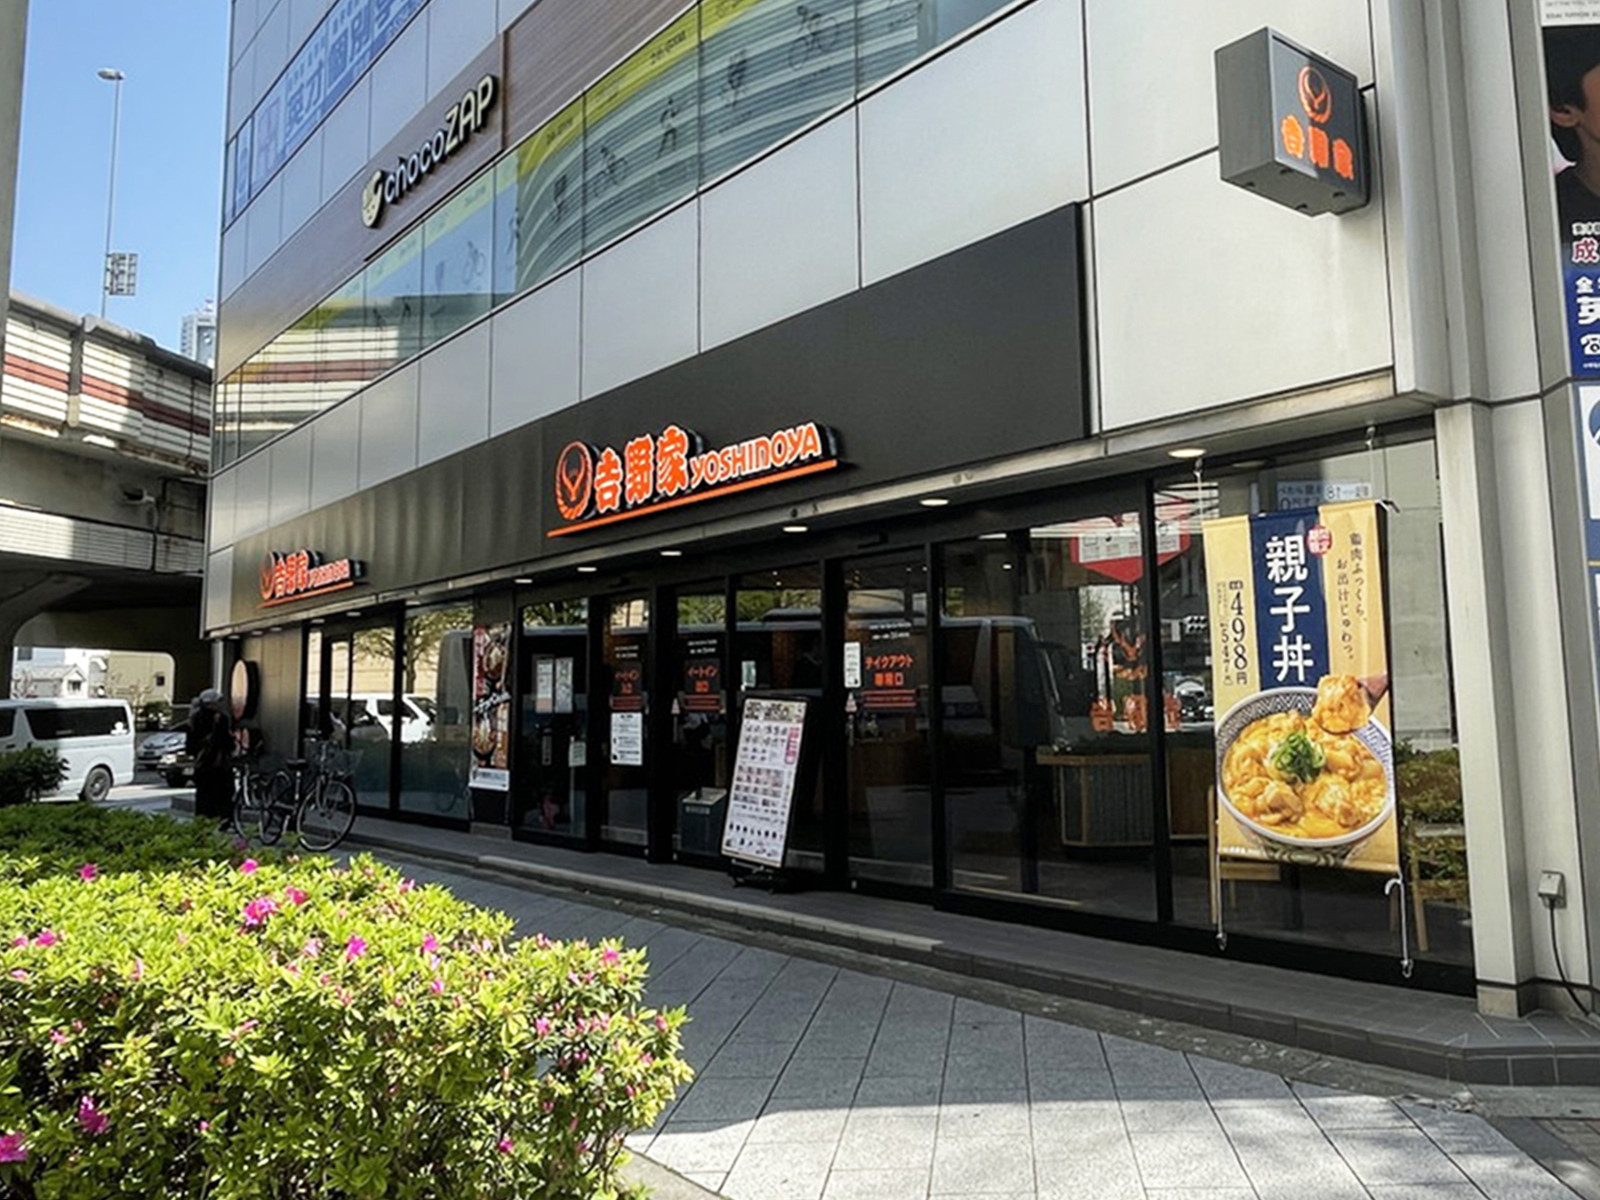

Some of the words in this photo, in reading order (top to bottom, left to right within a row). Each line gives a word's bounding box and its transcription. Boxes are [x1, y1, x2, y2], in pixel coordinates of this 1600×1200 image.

[384, 75, 493, 203] chocoZAP
[594, 425, 689, 513] 吉野家
[690, 421, 823, 489] YOSHINOYA
[1265, 534, 1315, 682] 親子丼
